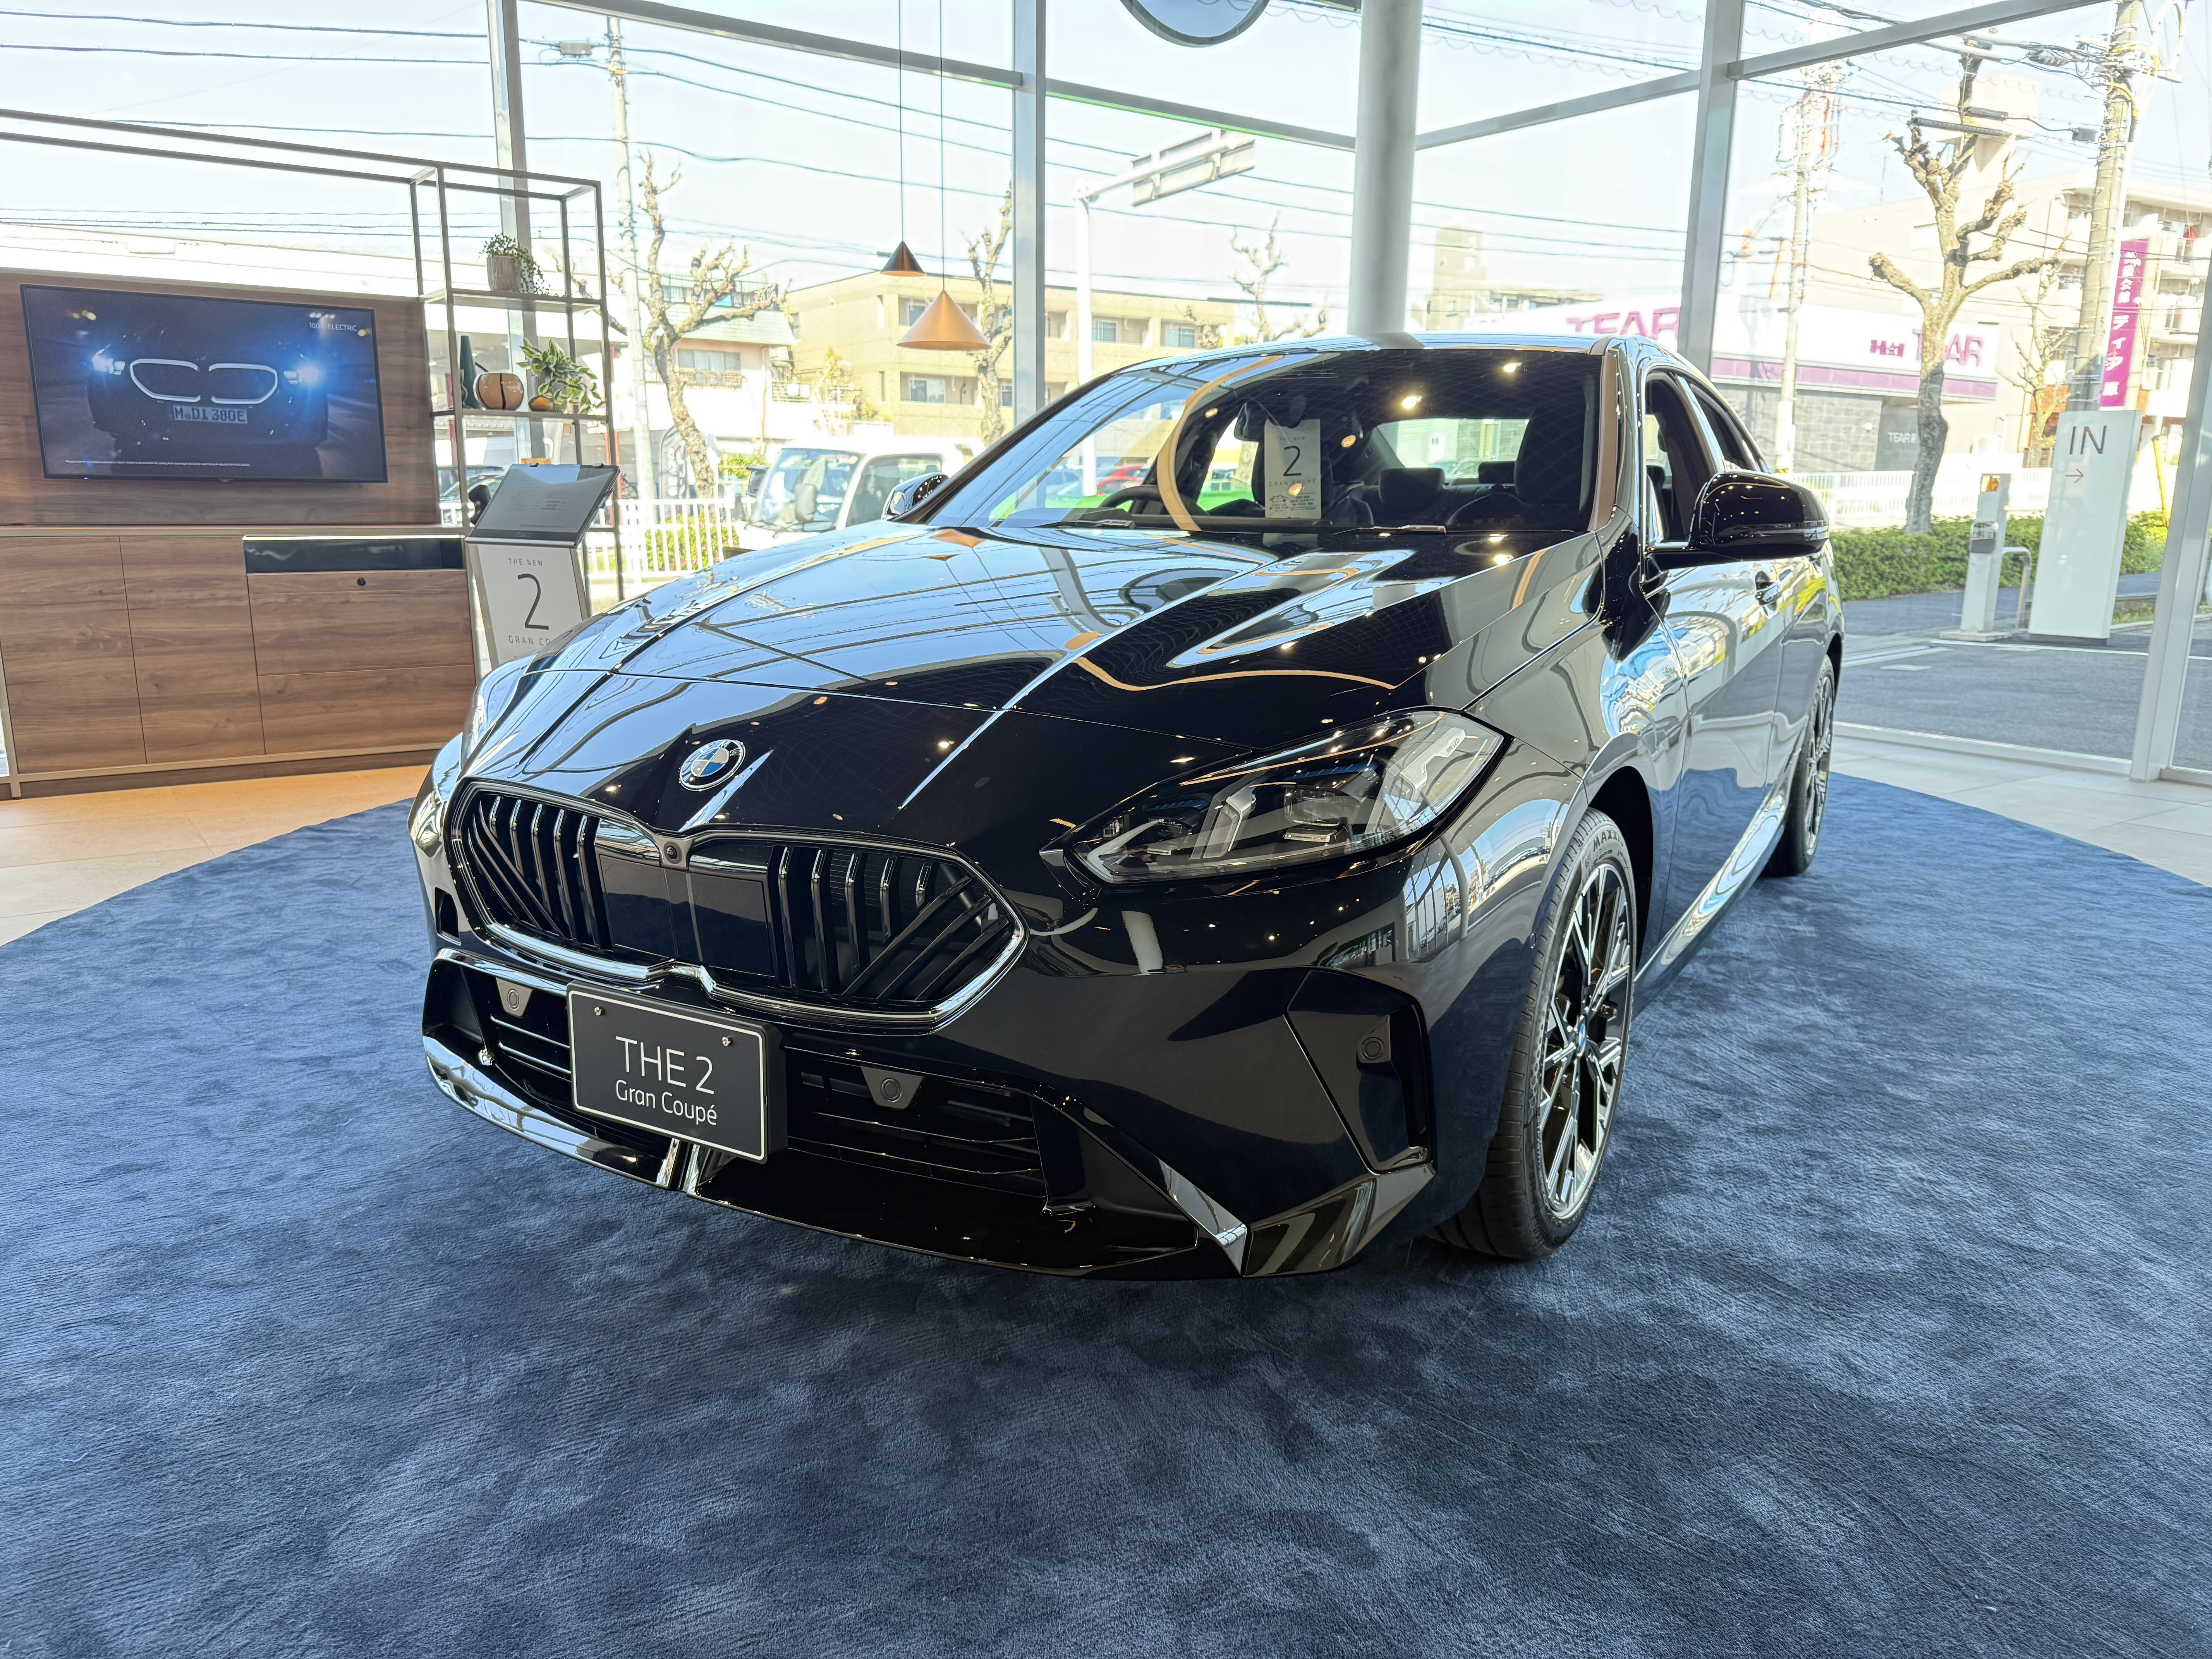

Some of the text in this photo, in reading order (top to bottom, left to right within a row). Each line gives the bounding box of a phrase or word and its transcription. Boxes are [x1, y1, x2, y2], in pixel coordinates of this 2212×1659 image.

[328, 323, 357, 332] ELECTRIC
[1566, 307, 1680, 340] TEAR
[1912, 328, 1983, 366] TAR
[174, 406, 184, 419] M
[2069, 425, 2107, 455] IN
[1283, 445, 1302, 477] 2
[517, 573, 550, 630] 2
[508, 635, 534, 645] GRAN
[1593, 829, 1624, 853] MAXXIS
[616, 1036, 714, 1095] THE 2
[616, 1079, 717, 1125] Gran Coupé
